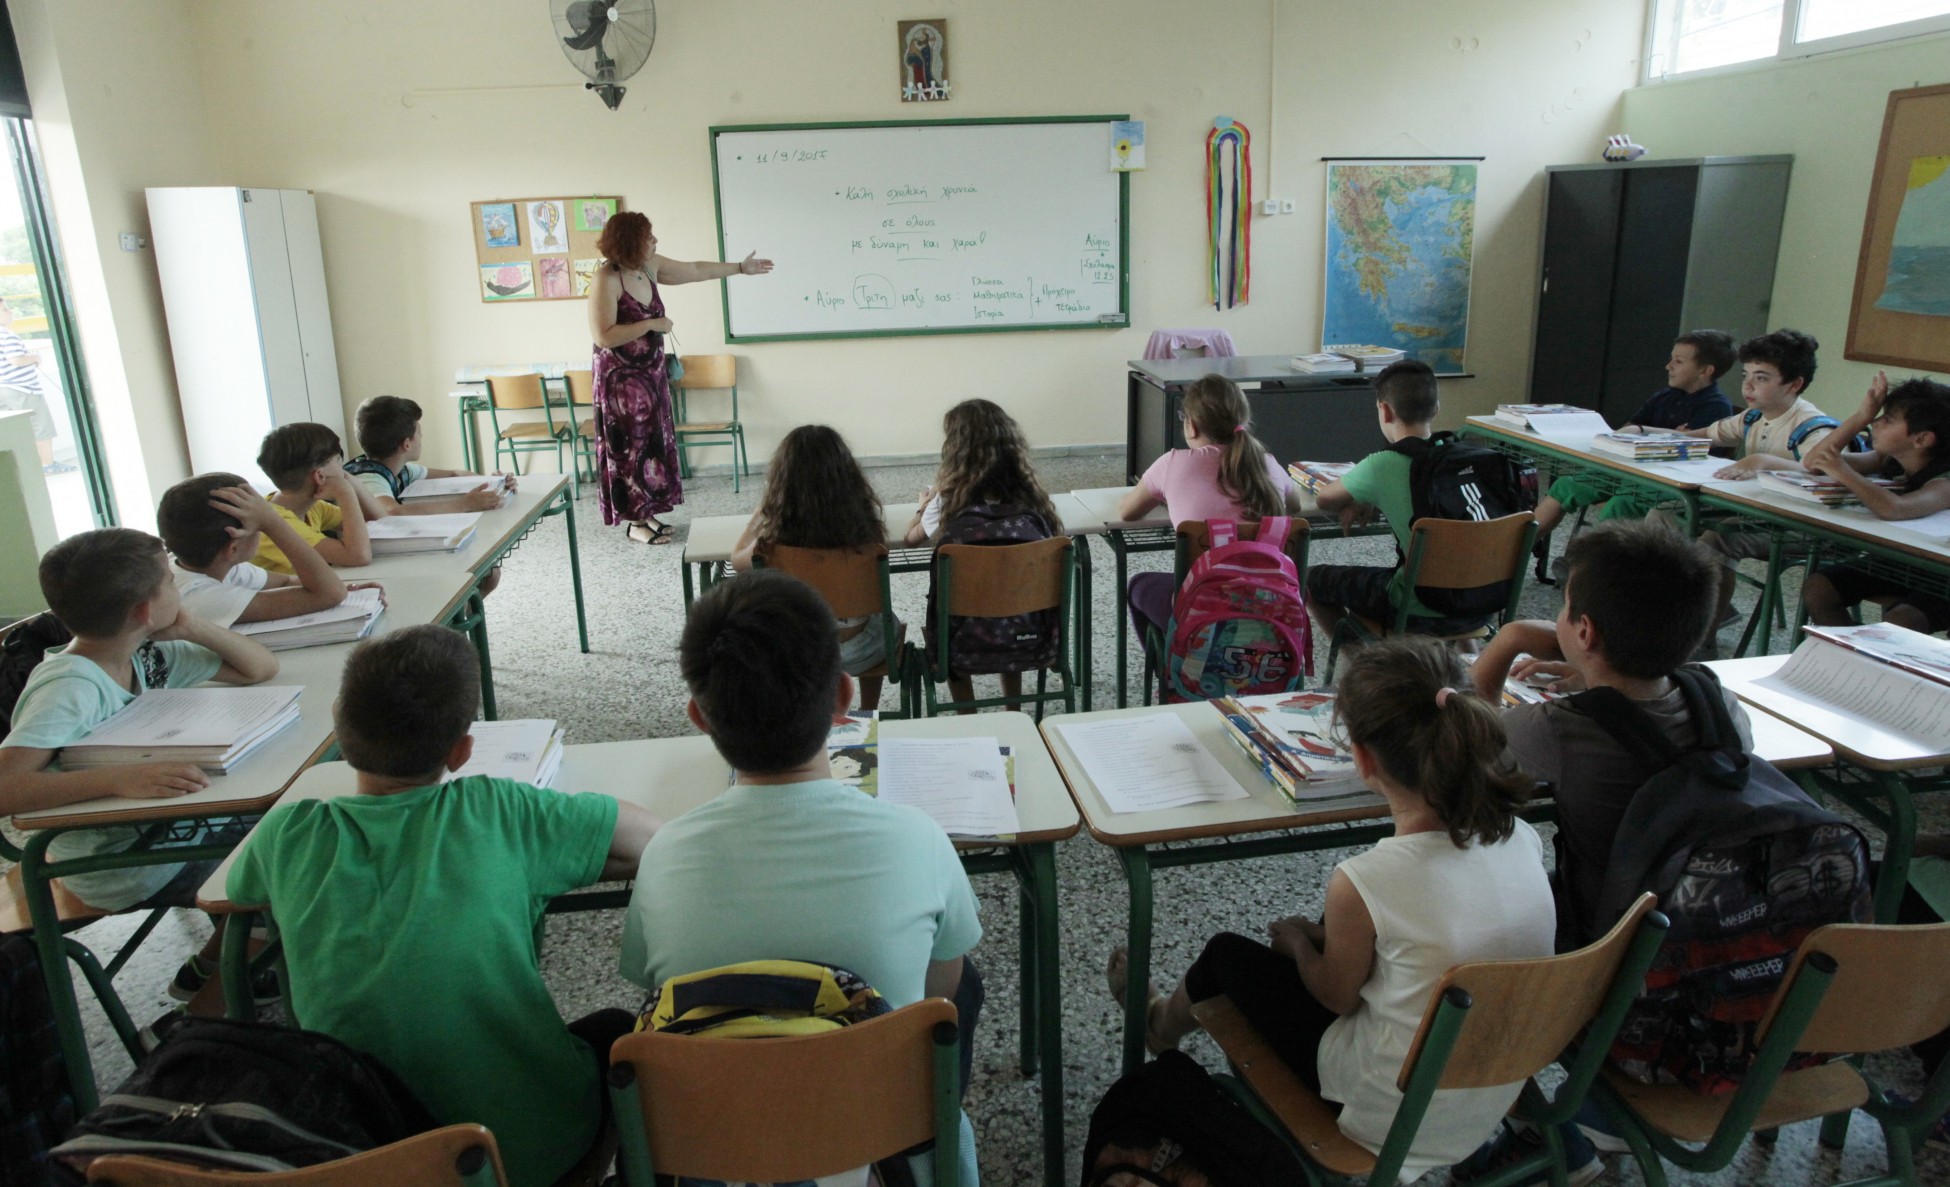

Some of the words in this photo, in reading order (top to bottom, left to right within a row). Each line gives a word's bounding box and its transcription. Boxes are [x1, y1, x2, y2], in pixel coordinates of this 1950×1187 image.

[756, 149, 828, 163] 11/9/2017
[886, 184, 928, 200] σχολική
[940, 184, 978, 200] χρονιά
[881, 217, 896, 228] σε
[851, 239, 863, 254] με
[870, 235, 910, 254] δύναμη
[923, 238, 940, 250] και
